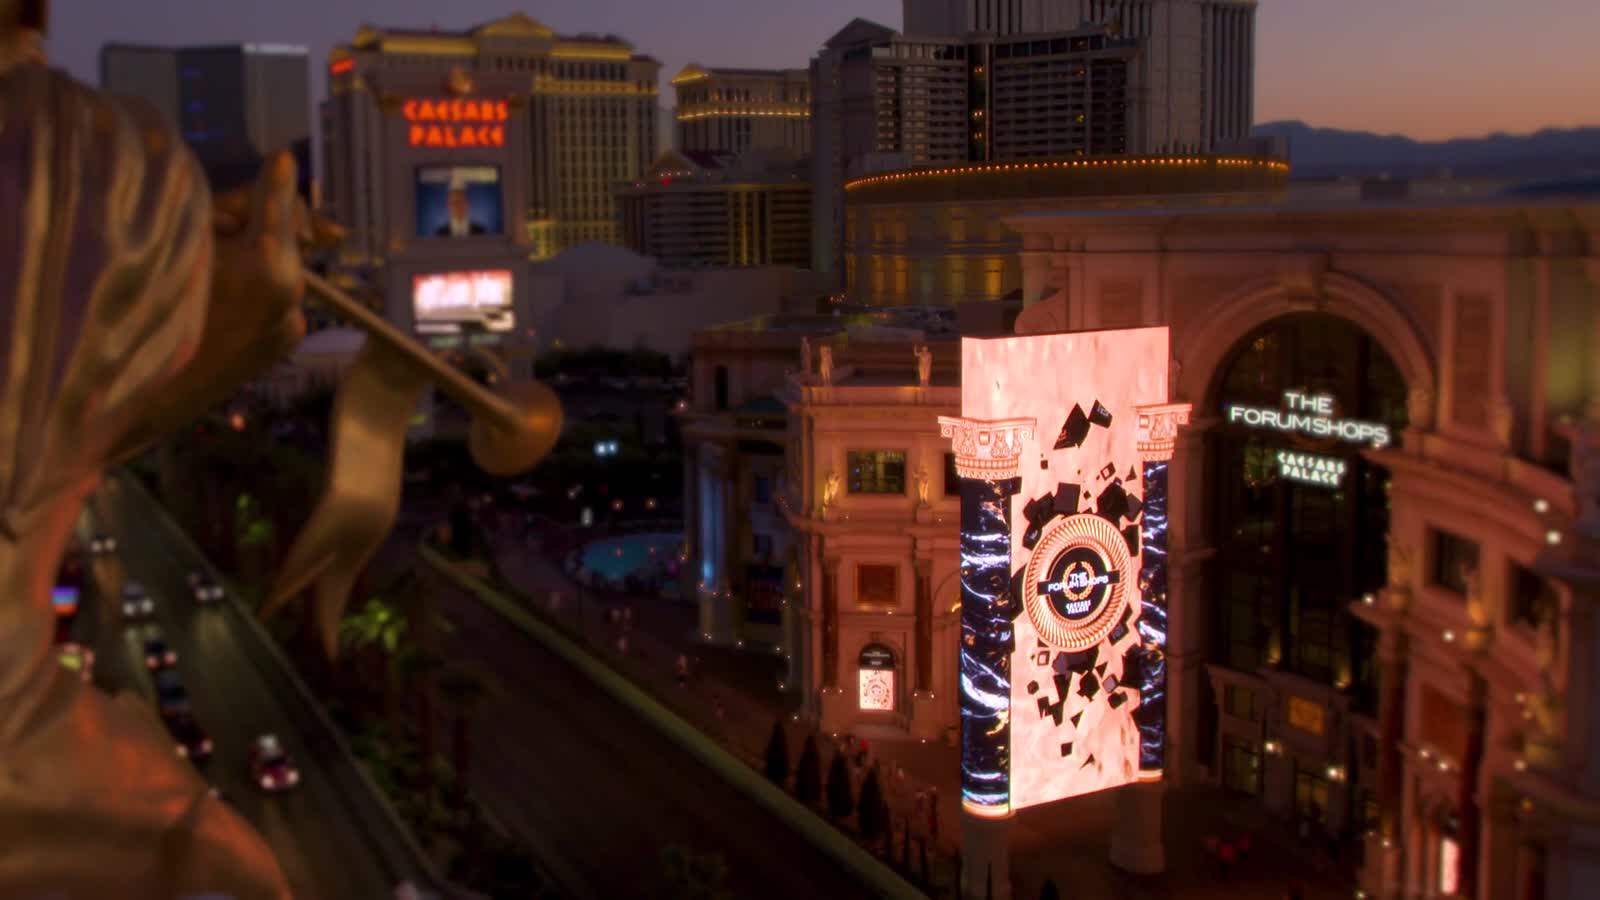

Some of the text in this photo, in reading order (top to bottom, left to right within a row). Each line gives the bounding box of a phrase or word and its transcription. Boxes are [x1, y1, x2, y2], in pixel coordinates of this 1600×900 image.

[402, 99, 509, 121] CAESARS
[408, 124, 505, 148] PALACE
[1285, 391, 1332, 414] THE
[1277, 451, 1345, 474] CAESARS
[1282, 464, 1339, 486] PALACE
